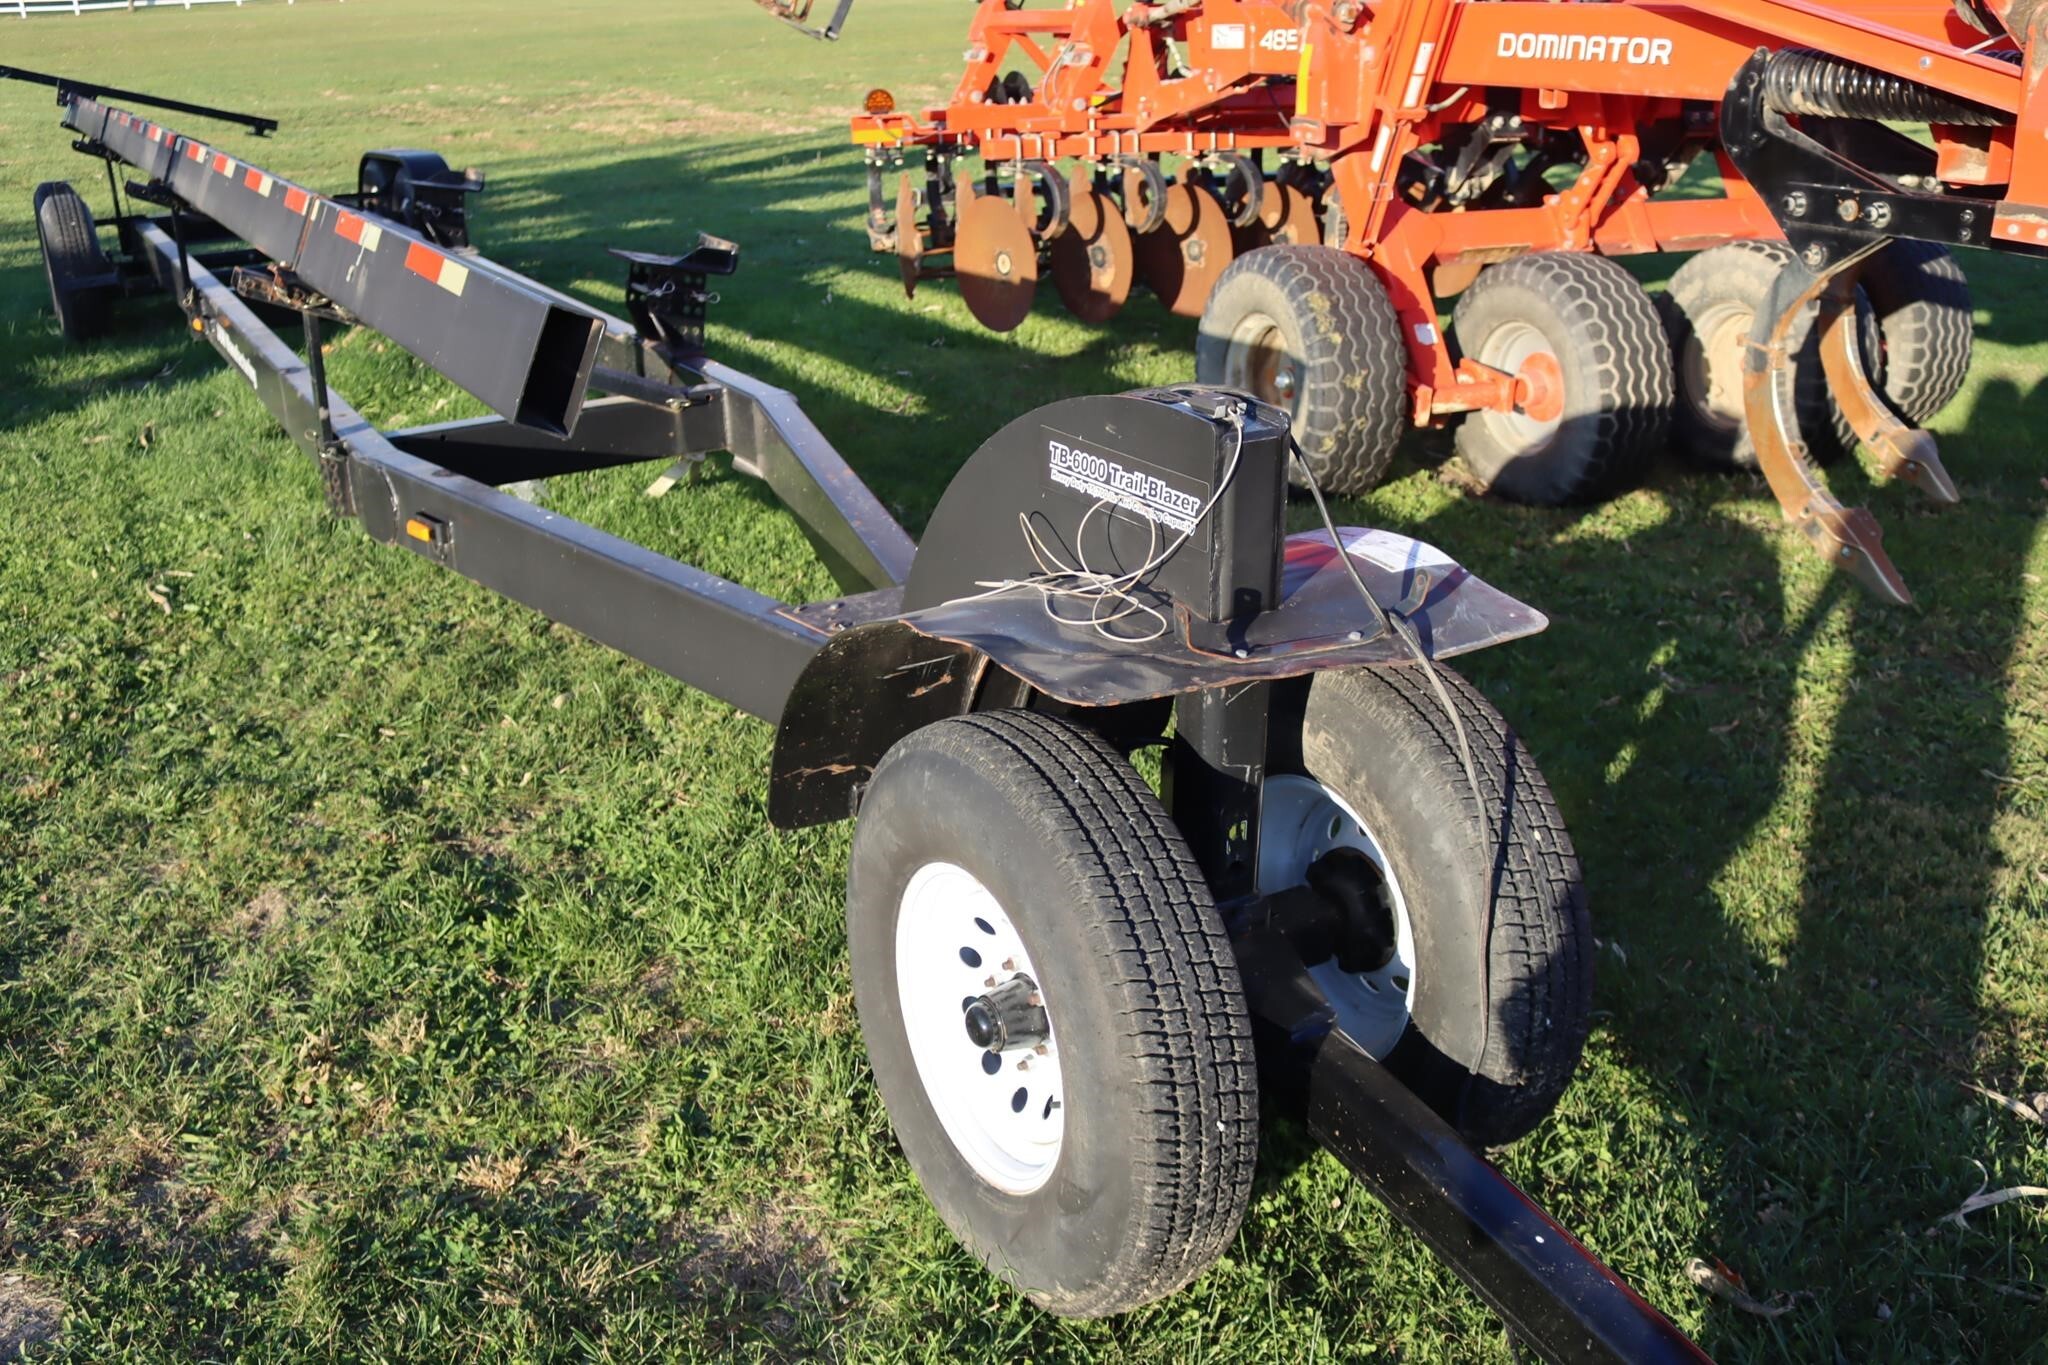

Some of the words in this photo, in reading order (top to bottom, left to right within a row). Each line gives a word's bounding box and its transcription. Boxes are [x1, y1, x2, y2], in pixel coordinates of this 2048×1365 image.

[1497, 32, 1673, 65] DOMINATOR
[1050, 441, 1107, 481] TB-6000
[1109, 463, 1200, 516] Trail-Blazer
